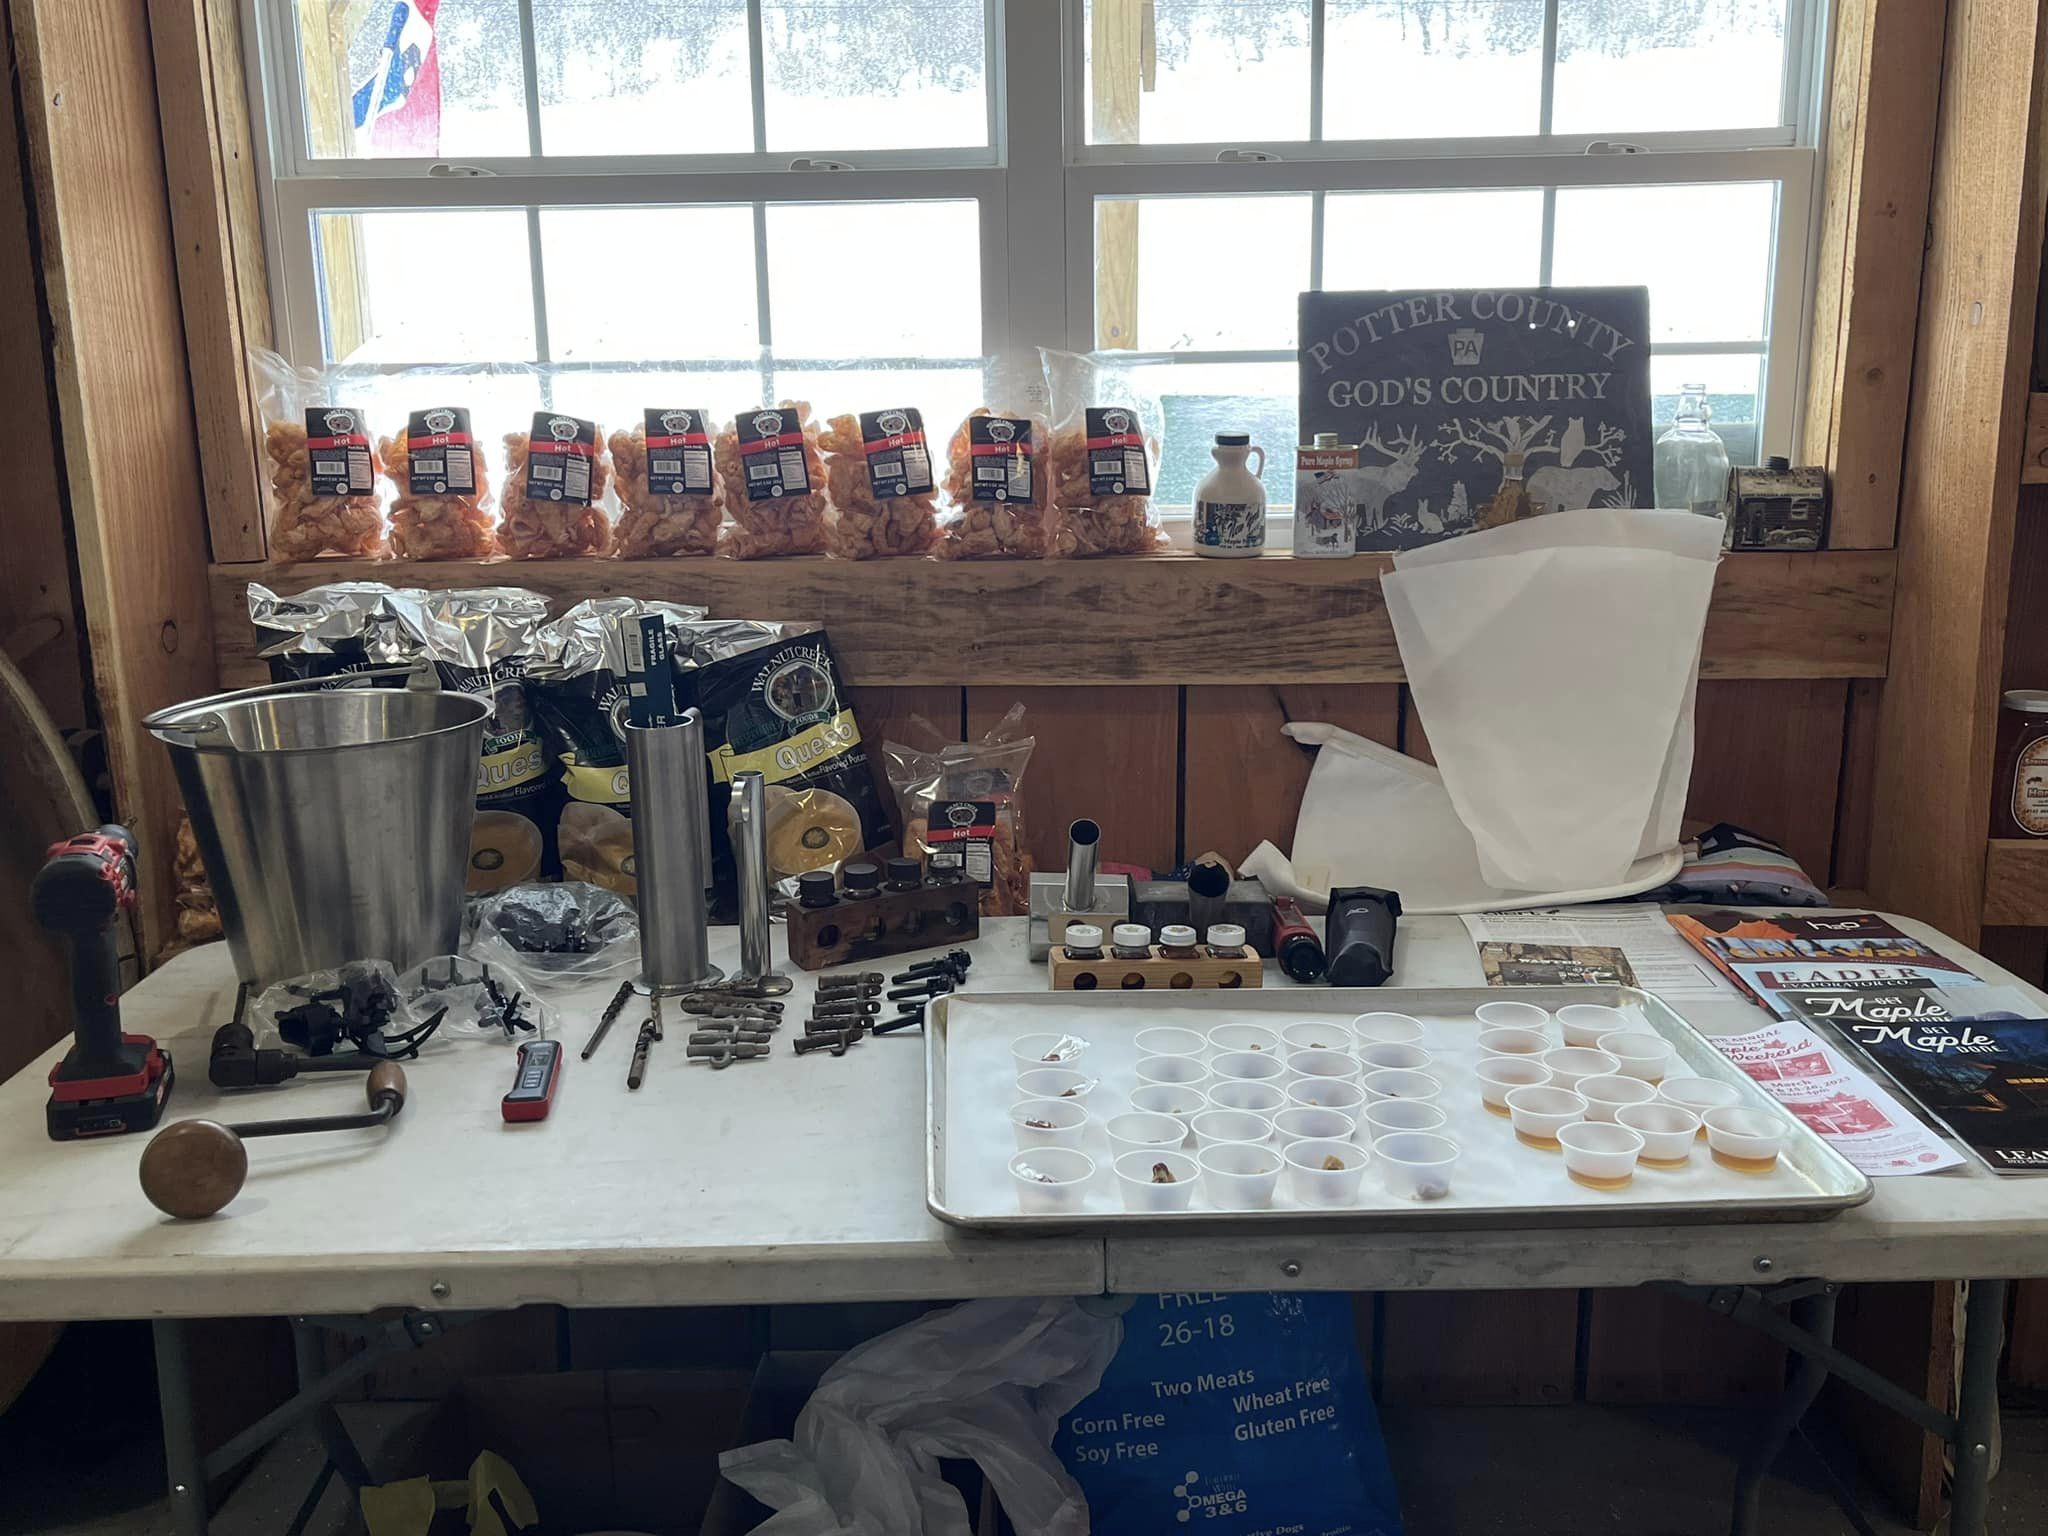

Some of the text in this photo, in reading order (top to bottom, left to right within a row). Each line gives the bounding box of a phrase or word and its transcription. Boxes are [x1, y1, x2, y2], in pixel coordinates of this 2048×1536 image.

[1308, 292, 1635, 375] POTTER COUNTY
[1454, 340, 1478, 356] PA
[1327, 372, 1611, 408] GOD'S COUNTRY
[432, 436, 449, 445] Hot
[554, 444, 571, 452] Hot
[670, 437, 686, 446] Hot
[1300, 455, 1315, 466] Pure
[647, 628, 657, 666] FRAGILE
[657, 631, 665, 660] GLASS
[752, 645, 834, 692] WALNUT CREEK
[795, 713, 820, 725] FOODS
[776, 722, 854, 771] Queso
[477, 751, 542, 787] Ques
[953, 829, 970, 839] Hot
[1756, 966, 1922, 989] LEADER
[1781, 979, 1884, 989] EVAPORATOR
[1804, 996, 1949, 1023] Maple
[1875, 996, 1903, 1005] GET
[1732, 1029, 1781, 1042] ANNUAL
[1852, 1025, 1996, 1053] Maple
[1921, 1026, 1949, 1035] GET
[1719, 1044, 1761, 1054] aple
[1725, 1038, 1813, 1060] Weekend
[1956, 1046, 2009, 1054] DONE
[1995, 1150, 2048, 1160] LEA
[1159, 1314, 1235, 1347] 26-18
[1152, 1369, 1255, 1399] Two Meats
[1232, 1375, 1331, 1414] Wheat Free
[1071, 1410, 1166, 1435] Corn Free
[1234, 1403, 1336, 1442] Gluten Free
[1075, 1439, 1159, 1465] Soy Free
[1188, 1488, 1248, 1509] OMEGA
[1275, 1523, 1304, 1536] Dogs
